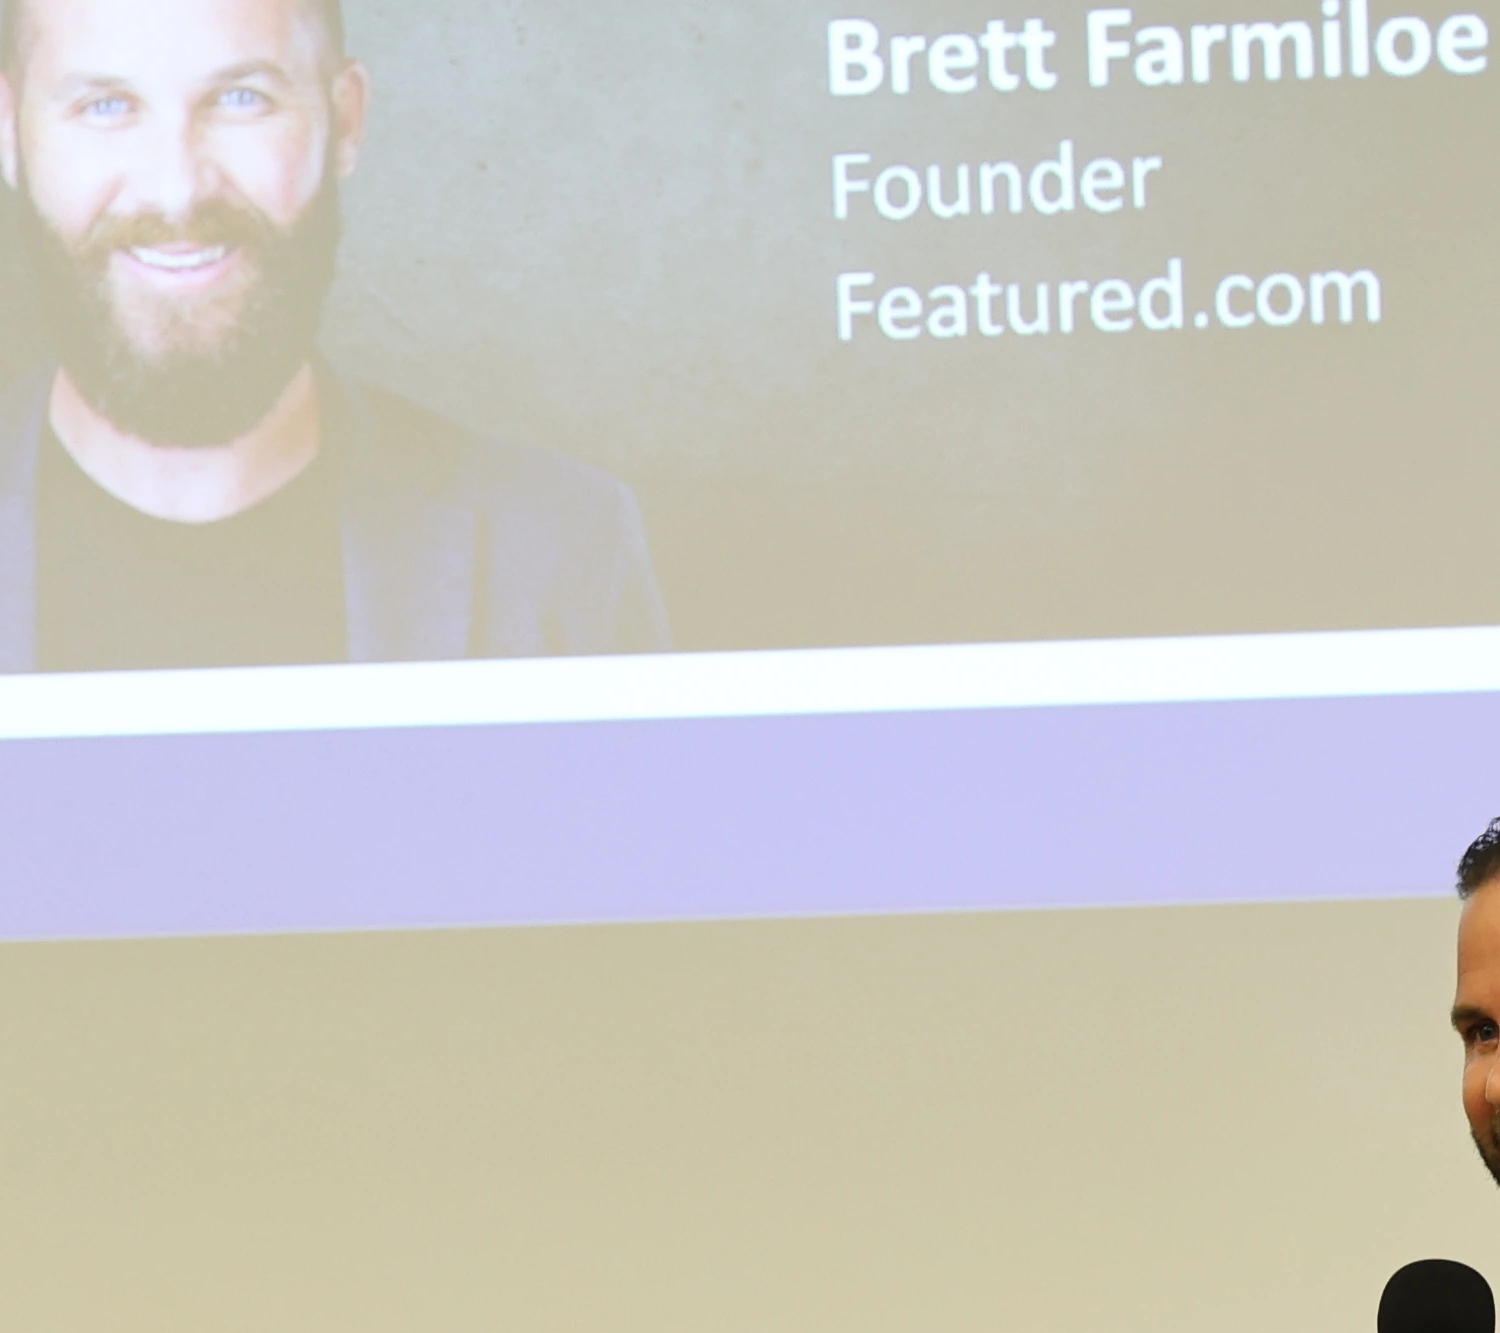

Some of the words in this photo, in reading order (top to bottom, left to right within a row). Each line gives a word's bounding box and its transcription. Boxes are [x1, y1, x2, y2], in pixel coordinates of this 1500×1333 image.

[826, 17, 1058, 96] Brett
[1086, 0, 1489, 88] Farmiloe
[831, 139, 1163, 220] Founder
[835, 257, 1383, 342] Featured.com
